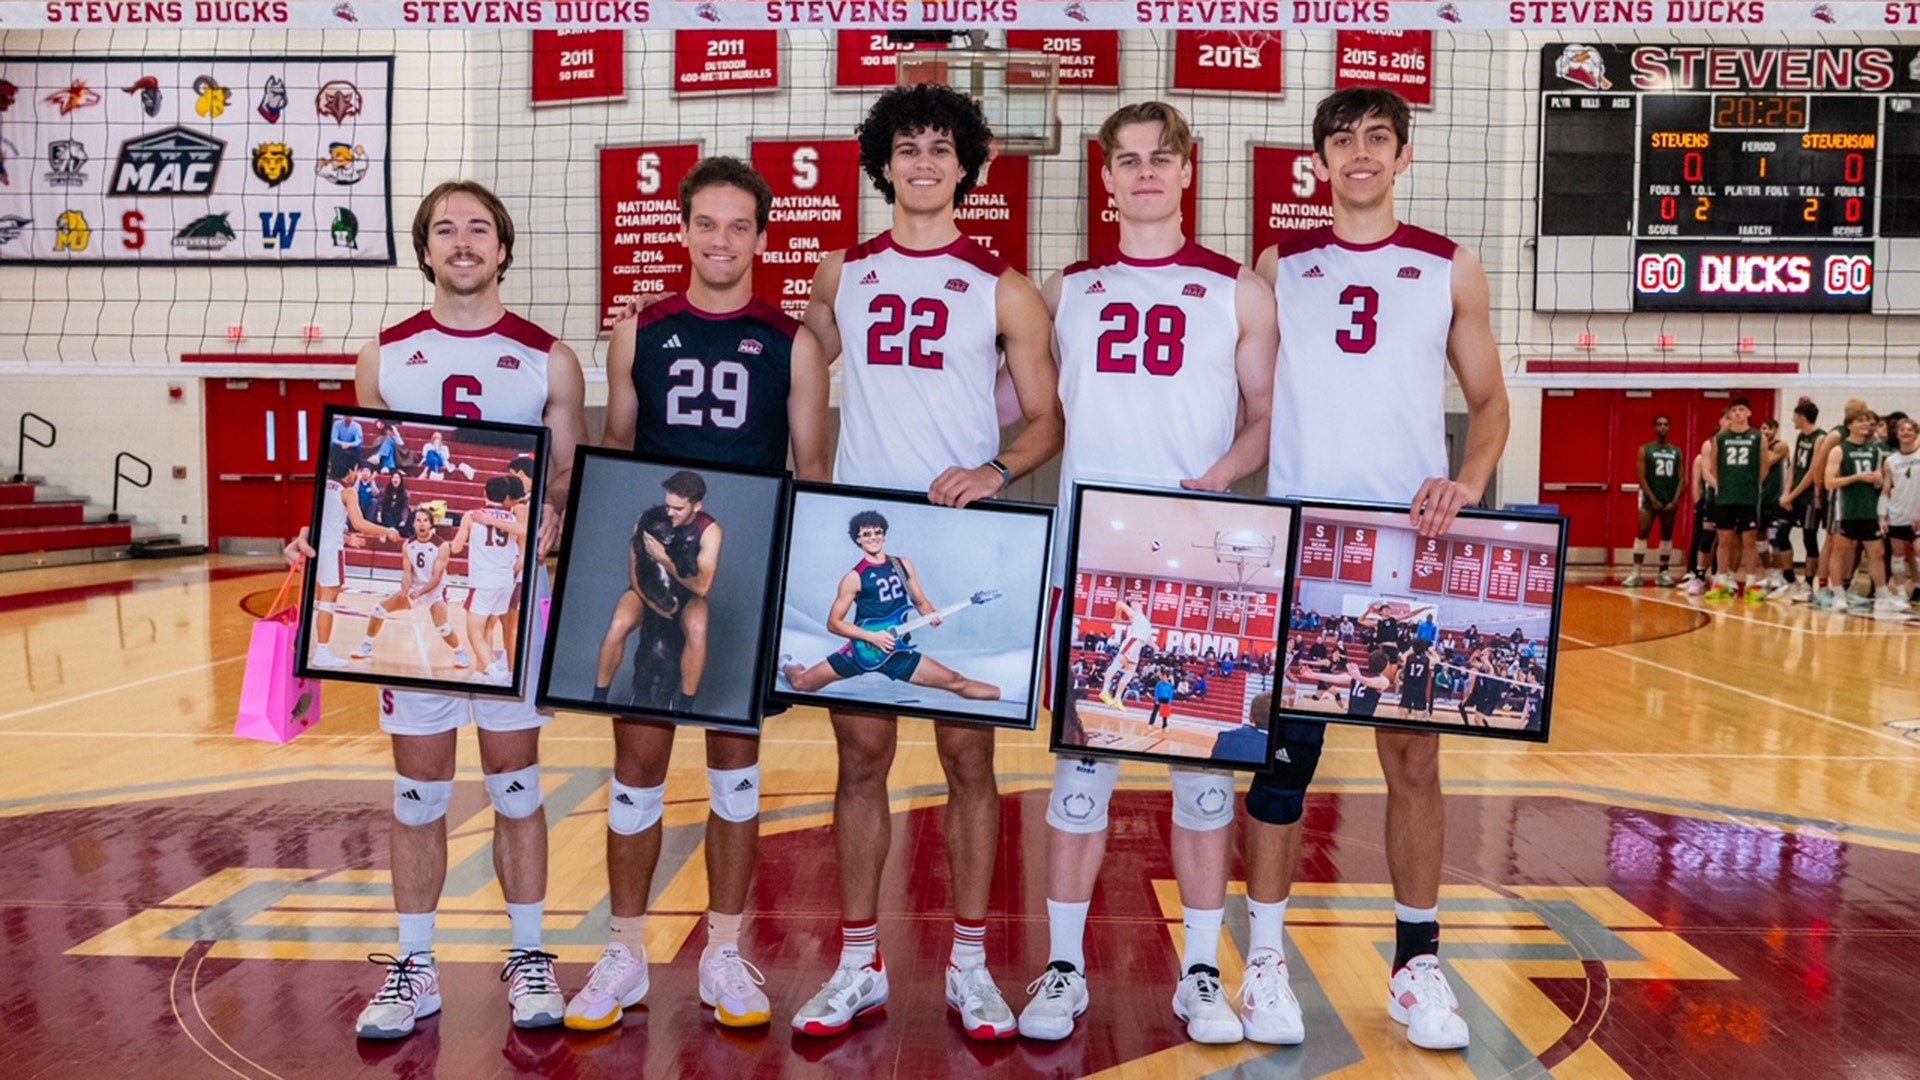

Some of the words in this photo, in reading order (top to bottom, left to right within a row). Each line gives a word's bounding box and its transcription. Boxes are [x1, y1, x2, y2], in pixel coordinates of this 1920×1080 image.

[47, 1, 183, 22] STEVENS
[195, 1, 289, 22] DUCKS
[403, 1, 543, 23] STEVENS
[555, 1, 650, 23] DUCKS
[767, 1, 908, 23] STEVENS
[922, 1, 1018, 23] DUCKS
[1136, 1, 1280, 23] STEVENS
[1292, 1, 1390, 23] DUCKS
[1509, 1, 1654, 24] STEVENS
[1667, 1, 1765, 24] DUCKS
[707, 39, 745, 56] 2011
[1043, 37, 1082, 51] 2015
[560, 49, 594, 67] 2011
[1059, 55, 1096, 66] REAST
[1198, 45, 1259, 68] 2015
[1342, 48, 1377, 66] 2015
[1379, 57, 1389, 67] &
[1391, 53, 1426, 71] 2016
[705, 60, 747, 71] OUTDOOR
[1631, 47, 1894, 91] STEVENS
[559, 71, 571, 82] 50
[573, 69, 595, 80] FREE
[680, 71, 730, 83] 400-METER
[731, 68, 772, 80] HURDLES
[1059, 69, 1095, 79] REAST
[1339, 68, 1376, 81] INDOOR
[1377, 71, 1400, 84] HIGH
[1402, 74, 1427, 85] JUMP
[1718, 98, 1804, 127] 20:26
[1651, 132, 1709, 148] STEVENS
[1742, 141, 1777, 152] PERIOD
[1802, 134, 1876, 149] STEVENSON
[637, 152, 661, 194] S
[792, 147, 819, 189] S
[1684, 152, 1703, 182] 0
[1759, 157, 1767, 178] 1
[1844, 153, 1864, 184] 0
[116, 162, 213, 192] MAC
[1292, 156, 1317, 198] S
[1650, 185, 1680, 196] FOULS
[1724, 186, 1761, 197] PLAYER
[1834, 187, 1865, 198] FOULS
[617, 200, 680, 213] NATIONAL
[771, 195, 840, 208] NATIONAL
[964, 194, 1008, 206] IONAL
[768, 209, 842, 222] CHAMPION
[953, 207, 1010, 220] AMPION
[1271, 203, 1333, 217] NATIONAL
[1660, 197, 1676, 221] 0
[1694, 197, 1711, 221] 2
[1803, 198, 1819, 222] 2
[1845, 198, 1861, 223] 0
[615, 213, 682, 227] CHAMPION
[122, 210, 146, 250] S
[259, 212, 301, 249] W
[614, 233, 640, 245] AMY
[643, 231, 682, 244] REGAN
[1648, 225, 1679, 236] SCORE
[1738, 226, 1772, 236] MATCH
[789, 237, 820, 249] GINA
[632, 251, 664, 264] 2014
[762, 252, 801, 264] DELLO
[804, 251, 829, 263] RUS
[613, 265, 641, 275] CROSS
[1637, 253, 1686, 293] GO
[1700, 255, 1812, 293] DUCKS
[1824, 255, 1873, 294] GO
[632, 280, 665, 292] 2016
[783, 279, 812, 295] 202
[1335, 284, 1379, 354] 3
[867, 293, 949, 371] 22
[1096, 302, 1187, 377] 28
[441, 373, 482, 421] 6
[666, 358, 750, 429] 29
[1726, 447, 1749, 465] 22
[1655, 459, 1674, 477] 20
[1316, 525, 1325, 538] S
[1355, 529, 1365, 542] S
[1427, 539, 1436, 552] S
[1464, 544, 1473, 556] S
[416, 552, 425, 568] 6
[1503, 549, 1512, 561] S
[1540, 554, 1548, 566] S
[876, 574, 904, 602] 22
[1165, 629, 1240, 661] POND
[1410, 663, 1424, 677] 17
[382, 688, 394, 716] S
